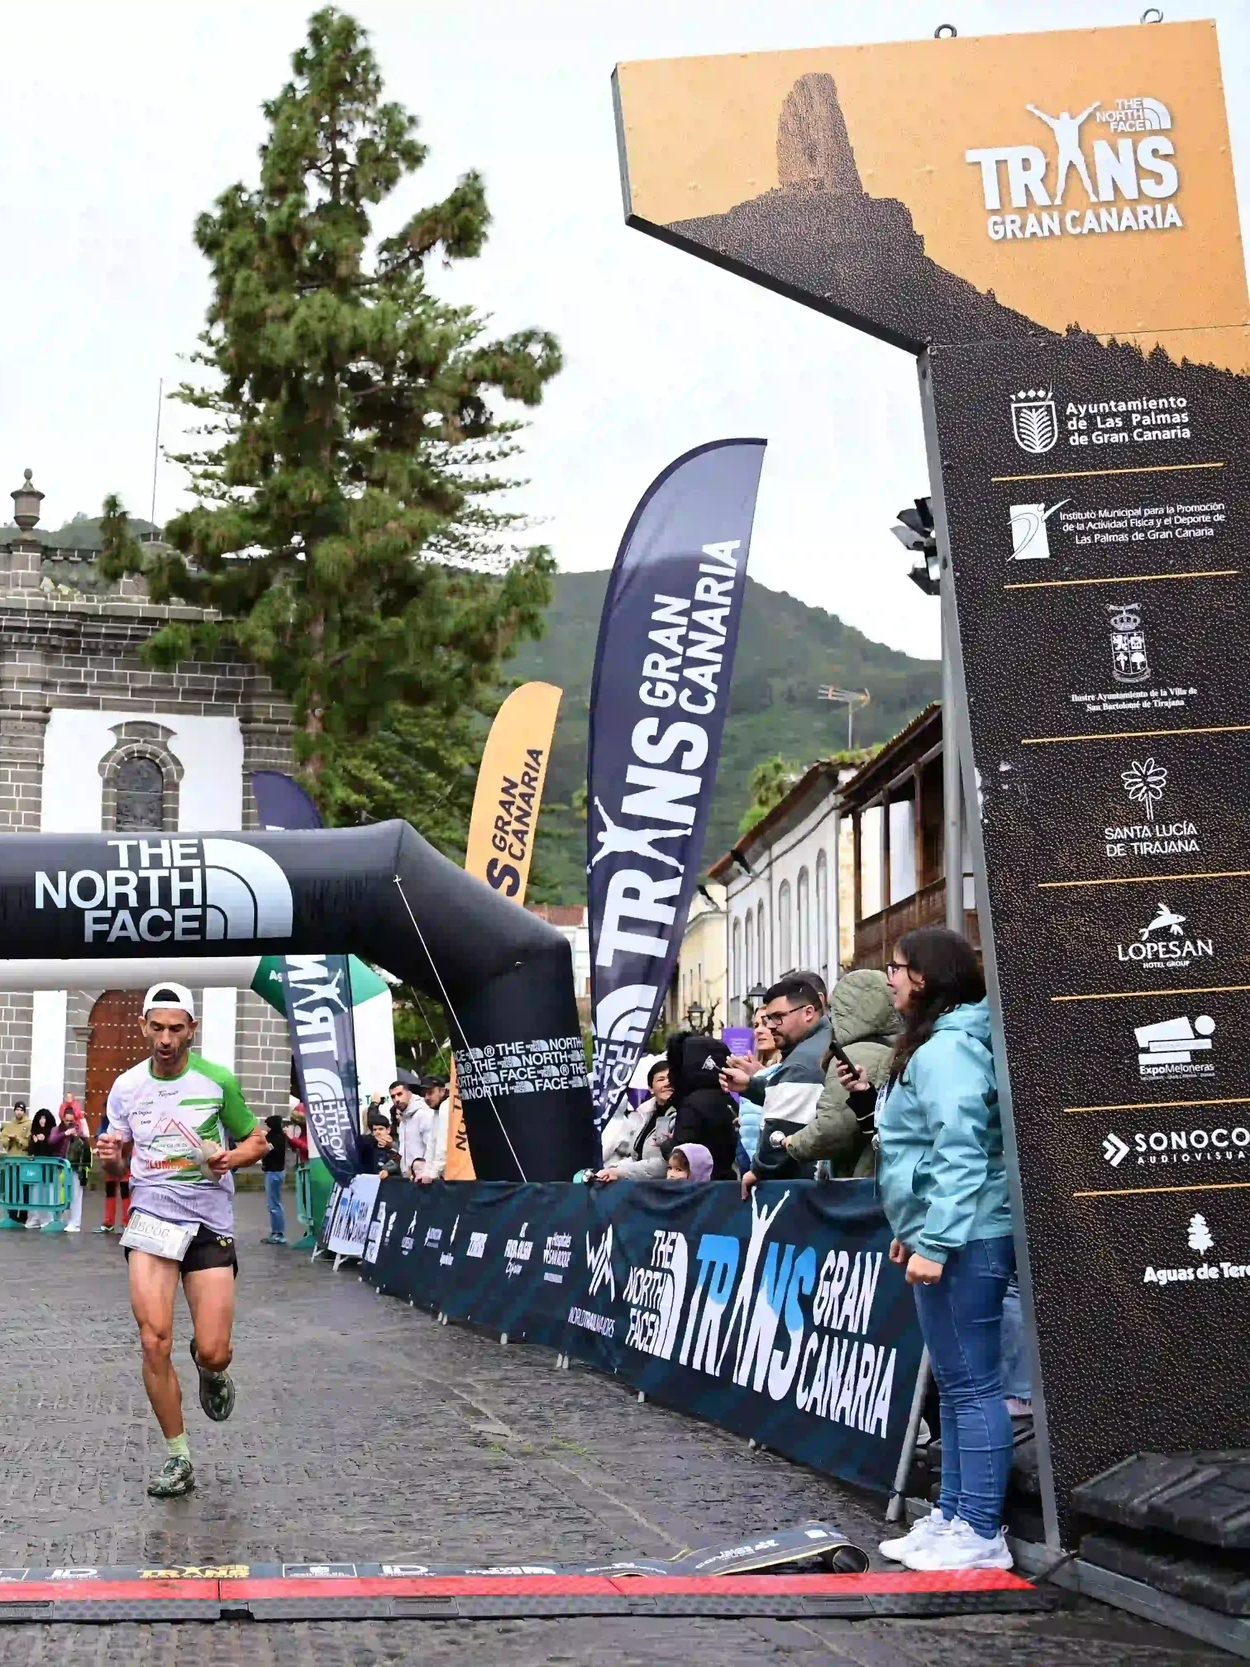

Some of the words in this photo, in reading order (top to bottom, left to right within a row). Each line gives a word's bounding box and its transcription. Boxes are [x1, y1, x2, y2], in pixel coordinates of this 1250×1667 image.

[1116, 98, 1143, 110] THE
[1096, 108, 1144, 123] NORTH
[1110, 120, 1145, 133] FACE
[987, 212, 1062, 241] GRAN
[1065, 202, 1183, 235] CANARIA
[1066, 396, 1188, 417] Ayuntamiento
[1068, 417, 1088, 431] de
[1097, 415, 1123, 429] Las
[1132, 411, 1189, 426] Palmas
[1069, 432, 1089, 446] de
[1092, 430, 1129, 445] Gran
[1133, 427, 1191, 442] Canaria
[1059, 511, 1096, 521] Instituto
[1098, 507, 1142, 519] Municipal
[1144, 508, 1165, 517] para
[1166, 504, 1175, 515] la
[1176, 502, 1225, 513] Promoción
[1062, 522, 1074, 532] de
[1076, 521, 1085, 531] la
[1087, 520, 1128, 531] Actividad
[1155, 518, 1162, 528] y
[1164, 516, 1172, 525] el
[1174, 514, 1212, 526] Deporte
[1213, 513, 1225, 522] de
[1075, 535, 1091, 545] Las
[1094, 532, 1129, 543] Palmas
[1132, 531, 1145, 541] de
[1148, 530, 1173, 540] Gran
[1175, 527, 1214, 538] Canaria
[679, 540, 741, 716] CANARIA
[639, 594, 691, 708] GRAN
[1097, 691, 1149, 702] Ayuntamiento
[1150, 689, 1159, 697] de
[1188, 687, 1198, 695] de
[1142, 700, 1152, 708] de
[1152, 699, 1185, 709] Tirajana
[491, 776, 519, 854] GRAN
[507, 748, 544, 862] CANARIA
[1104, 825, 1151, 840] SANTA
[1156, 820, 1198, 838] LUCÍA
[107, 839, 202, 868] THE
[1106, 843, 1127, 857] DE
[1130, 840, 1200, 857] TIRAJANA
[35, 868, 202, 910] NORTH
[84, 908, 202, 943] FACE
[1117, 939, 1213, 962] LOPESAN
[1142, 962, 1165, 970] HOTEL
[1166, 960, 1191, 969] GROUP
[495, 1041, 526, 1056] THE
[472, 1058, 498, 1073] THE
[521, 1050, 569, 1066] NORTH
[1139, 1063, 1215, 1076] ExpoMeloneras
[458, 1074, 479, 1088] ORTH
[499, 1067, 536, 1082] FACE
[469, 1083, 510, 1100] NORTH
[535, 1077, 569, 1092] FACE
[652, 1230, 675, 1267] THE
[1143, 1266, 1194, 1286] Aguas
[1196, 1262, 1220, 1280] de
[623, 1266, 666, 1309] NORTH
[813, 1250, 883, 1335] GRAN
[625, 1307, 660, 1354] FACE
[796, 1336, 897, 1439] CANARIA
